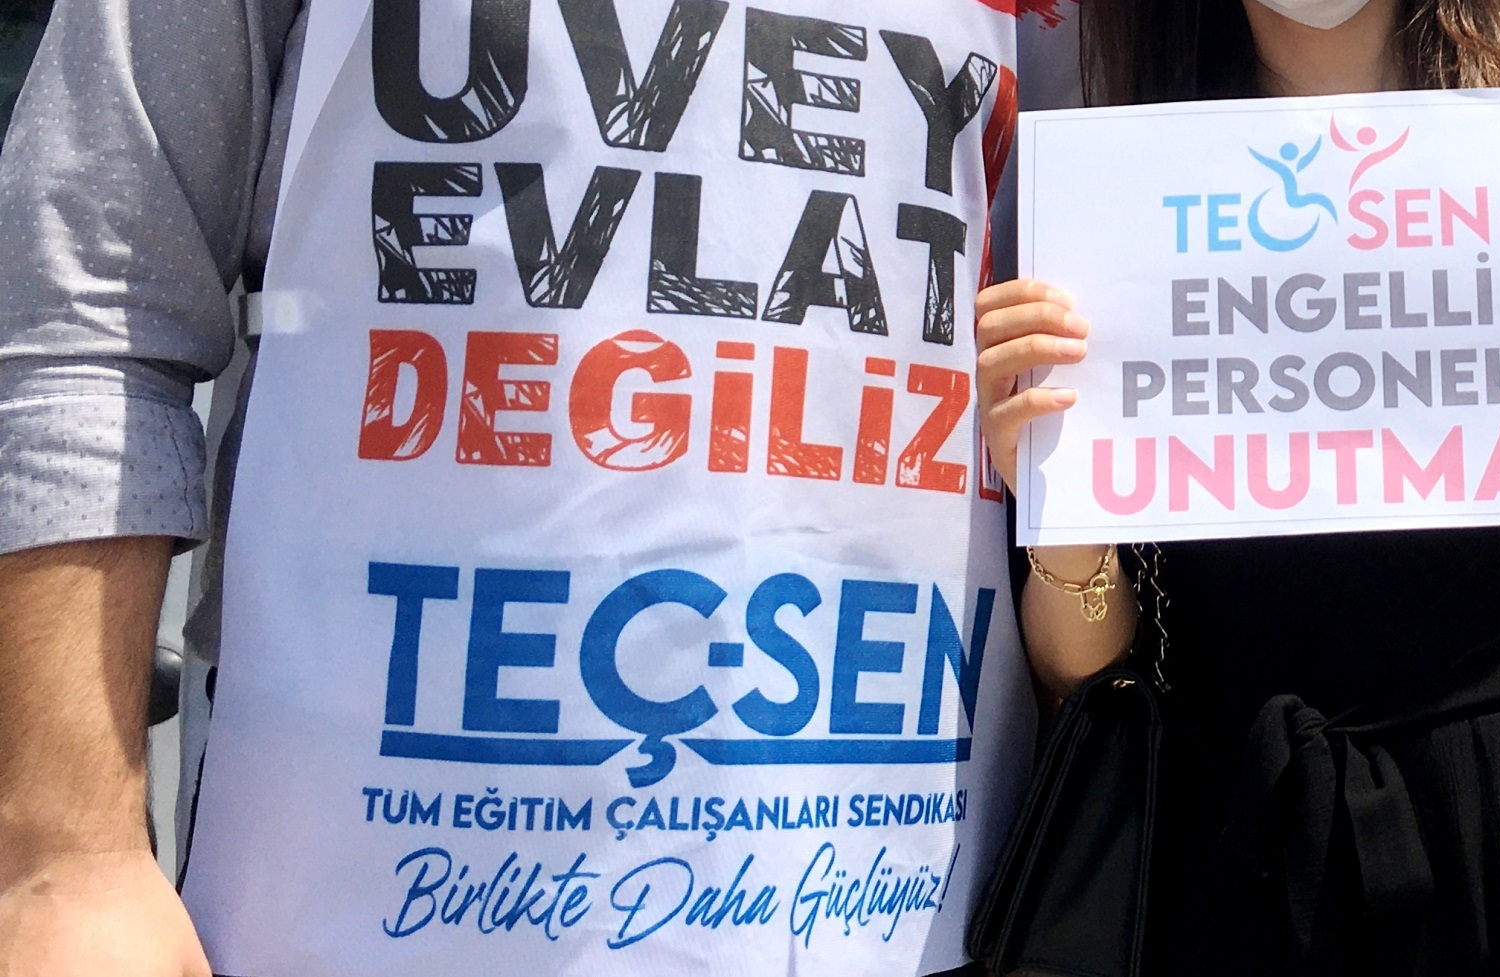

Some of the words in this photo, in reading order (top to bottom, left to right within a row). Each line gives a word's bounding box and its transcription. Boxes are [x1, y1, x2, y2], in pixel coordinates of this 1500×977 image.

[371, 161, 968, 345] EVLAT
[1171, 252, 1495, 336] ENGELLİ
[367, 561, 996, 788] TEÇ-SEN
[453, 787, 593, 831] EĞİTİM
[606, 795, 839, 841] ÇALIŞANLARI
[847, 789, 967, 826] SENDİKASI
[384, 846, 601, 939] Birlikte
[606, 854, 780, 950] Daha
[789, 842, 962, 950] Güçlüyüz!
